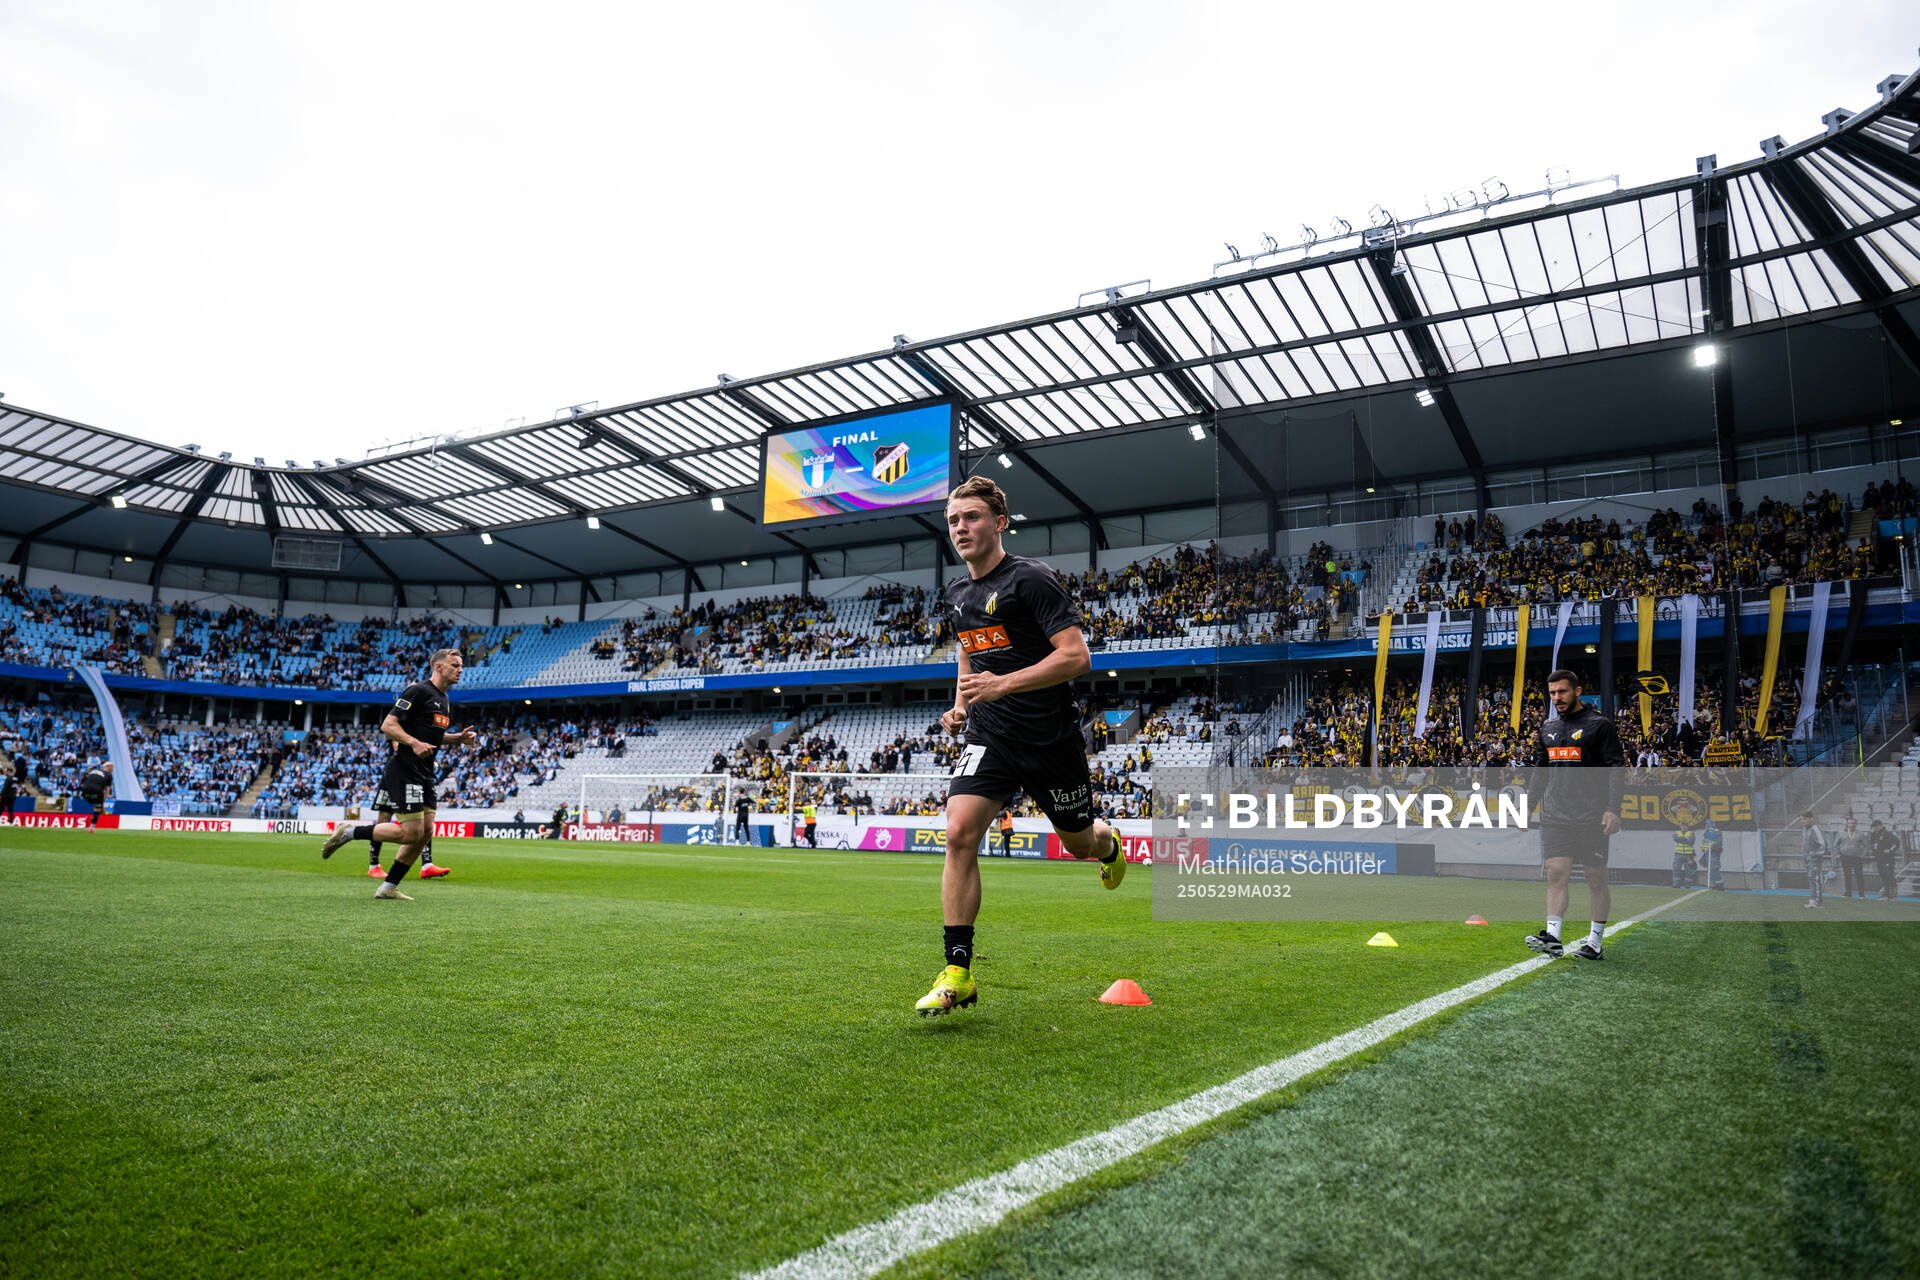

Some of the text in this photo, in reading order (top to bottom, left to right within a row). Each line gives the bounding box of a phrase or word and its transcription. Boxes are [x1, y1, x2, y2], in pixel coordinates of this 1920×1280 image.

[832, 430, 878, 447] FINAL
[960, 631, 1005, 648] BRA
[1372, 637, 1410, 650] FNAL
[1411, 634, 1472, 649] SVNSKA
[628, 678, 704, 693] FINAL SVENSKA CUPEN
[1049, 784, 1087, 803] Varis
[1621, 794, 1660, 820] 20
[1709, 795, 1752, 821] 22
[0, 814, 87, 828] BAUHAUS
[152, 820, 231, 832] BAUHAUS
[267, 821, 308, 834] MOBILL
[484, 825, 521, 839] beans
[914, 829, 946, 845] FAS
[1250, 847, 1375, 863] SVENSKA CUPEN
